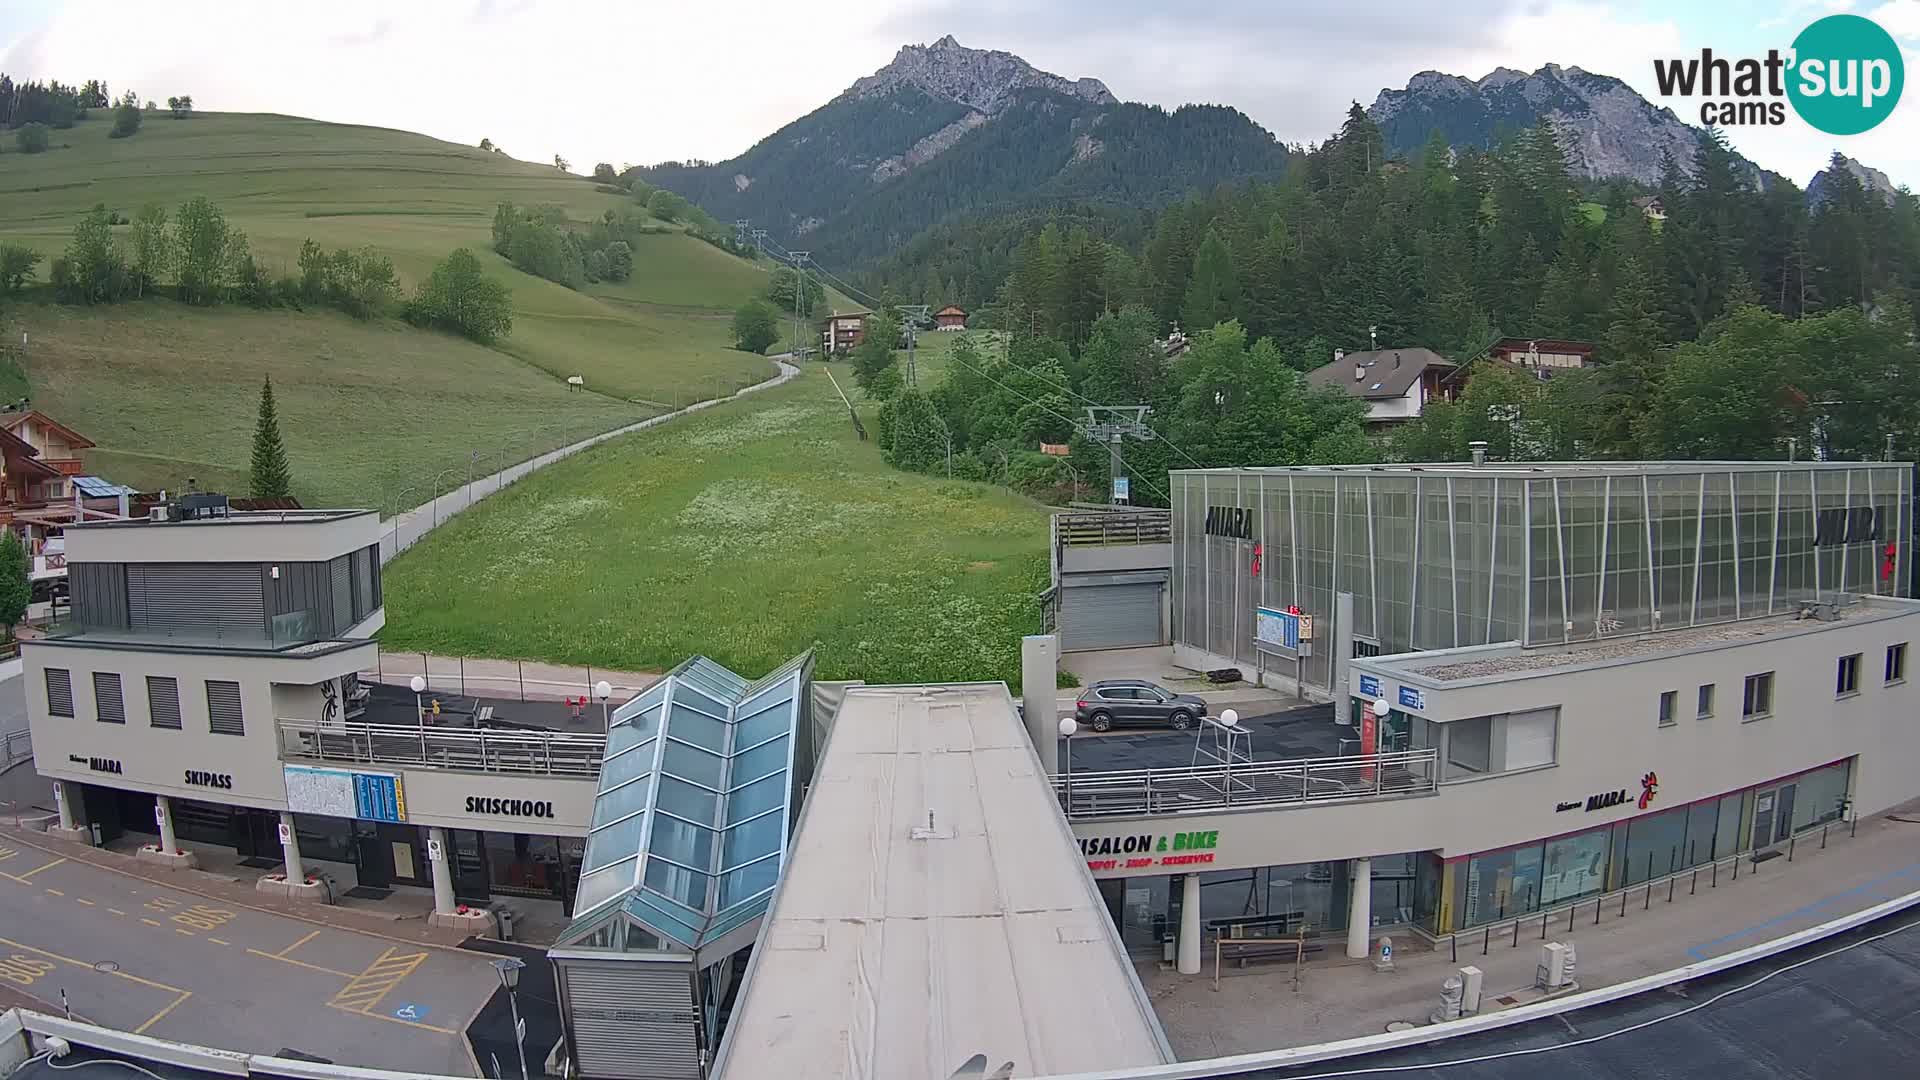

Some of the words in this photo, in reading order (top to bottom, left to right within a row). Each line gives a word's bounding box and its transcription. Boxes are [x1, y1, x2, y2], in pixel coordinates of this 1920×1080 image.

[1205, 505, 1252, 540] MIARA
[90, 757, 122, 775] MIARA
[184, 769, 232, 789] SKIPASS
[465, 796, 554, 818] SKISCHOOL
[1585, 789, 1627, 812] MIARA
[1156, 836, 1168, 852] &
[1173, 830, 1218, 851] BIKE
[170, 904, 237, 930] BUS
